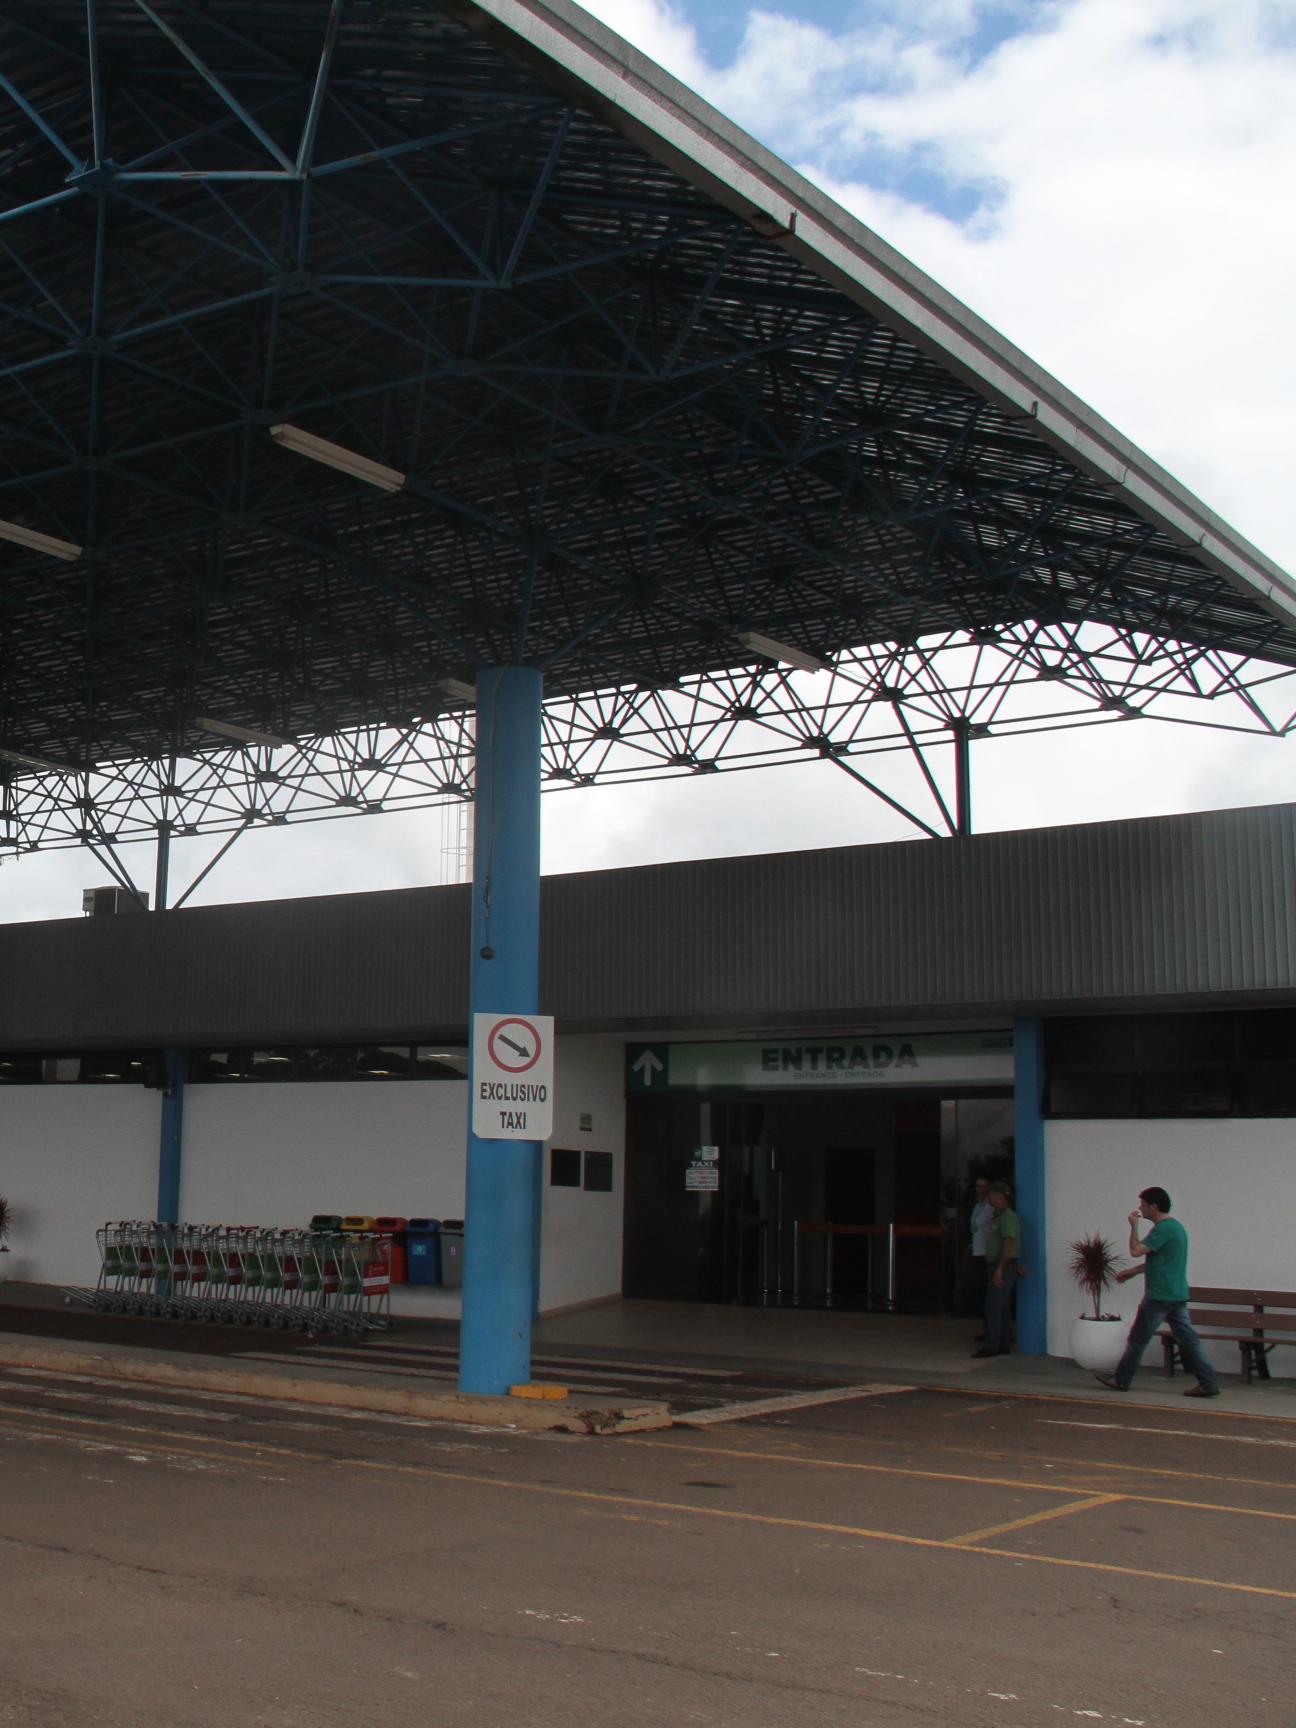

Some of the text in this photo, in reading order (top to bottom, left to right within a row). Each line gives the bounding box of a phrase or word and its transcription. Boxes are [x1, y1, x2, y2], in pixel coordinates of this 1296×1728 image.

[762, 1043, 919, 1071] ENTRADA
[794, 1071, 837, 1080] ENTRANCE
[845, 1070, 885, 1079] ENTRADA
[480, 1081, 547, 1103] EXCLUSIVO
[499, 1110, 526, 1129] TAXI
